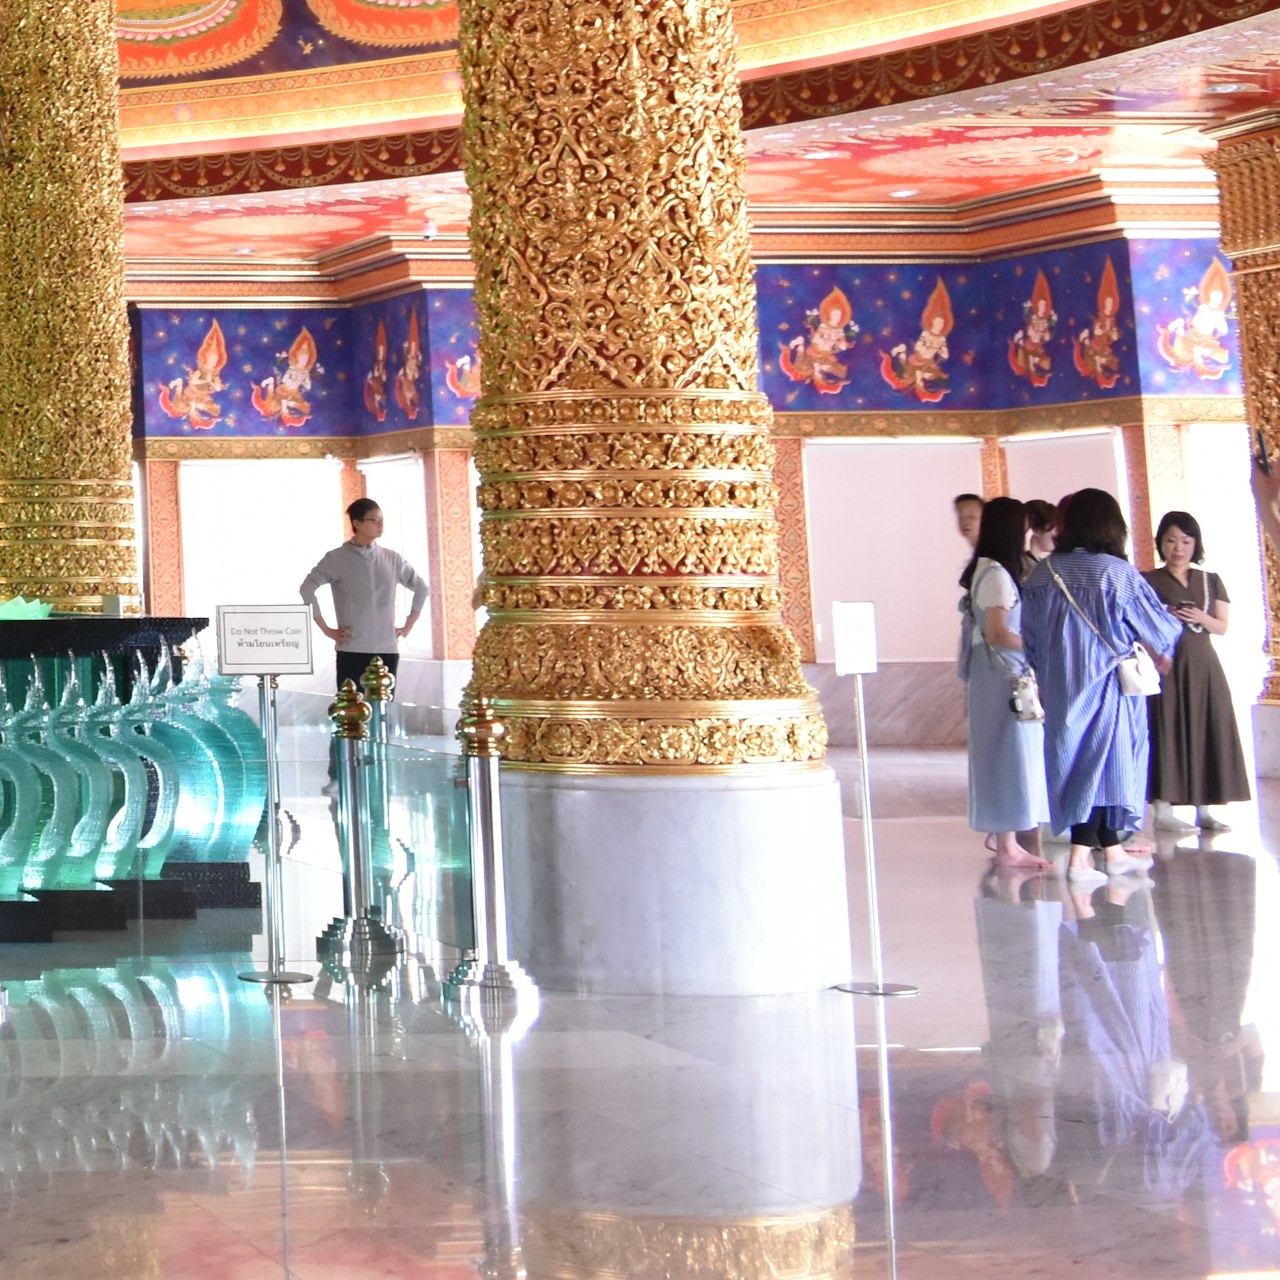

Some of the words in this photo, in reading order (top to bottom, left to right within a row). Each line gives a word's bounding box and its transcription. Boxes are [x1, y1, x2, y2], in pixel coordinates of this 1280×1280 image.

[230, 627, 242, 635] Do
[244, 627, 258, 635] Not
[260, 627, 283, 635] Throw
[285, 627, 303, 635] Coin
[237, 638, 299, 649] ห้ามโยนเหรียญ
